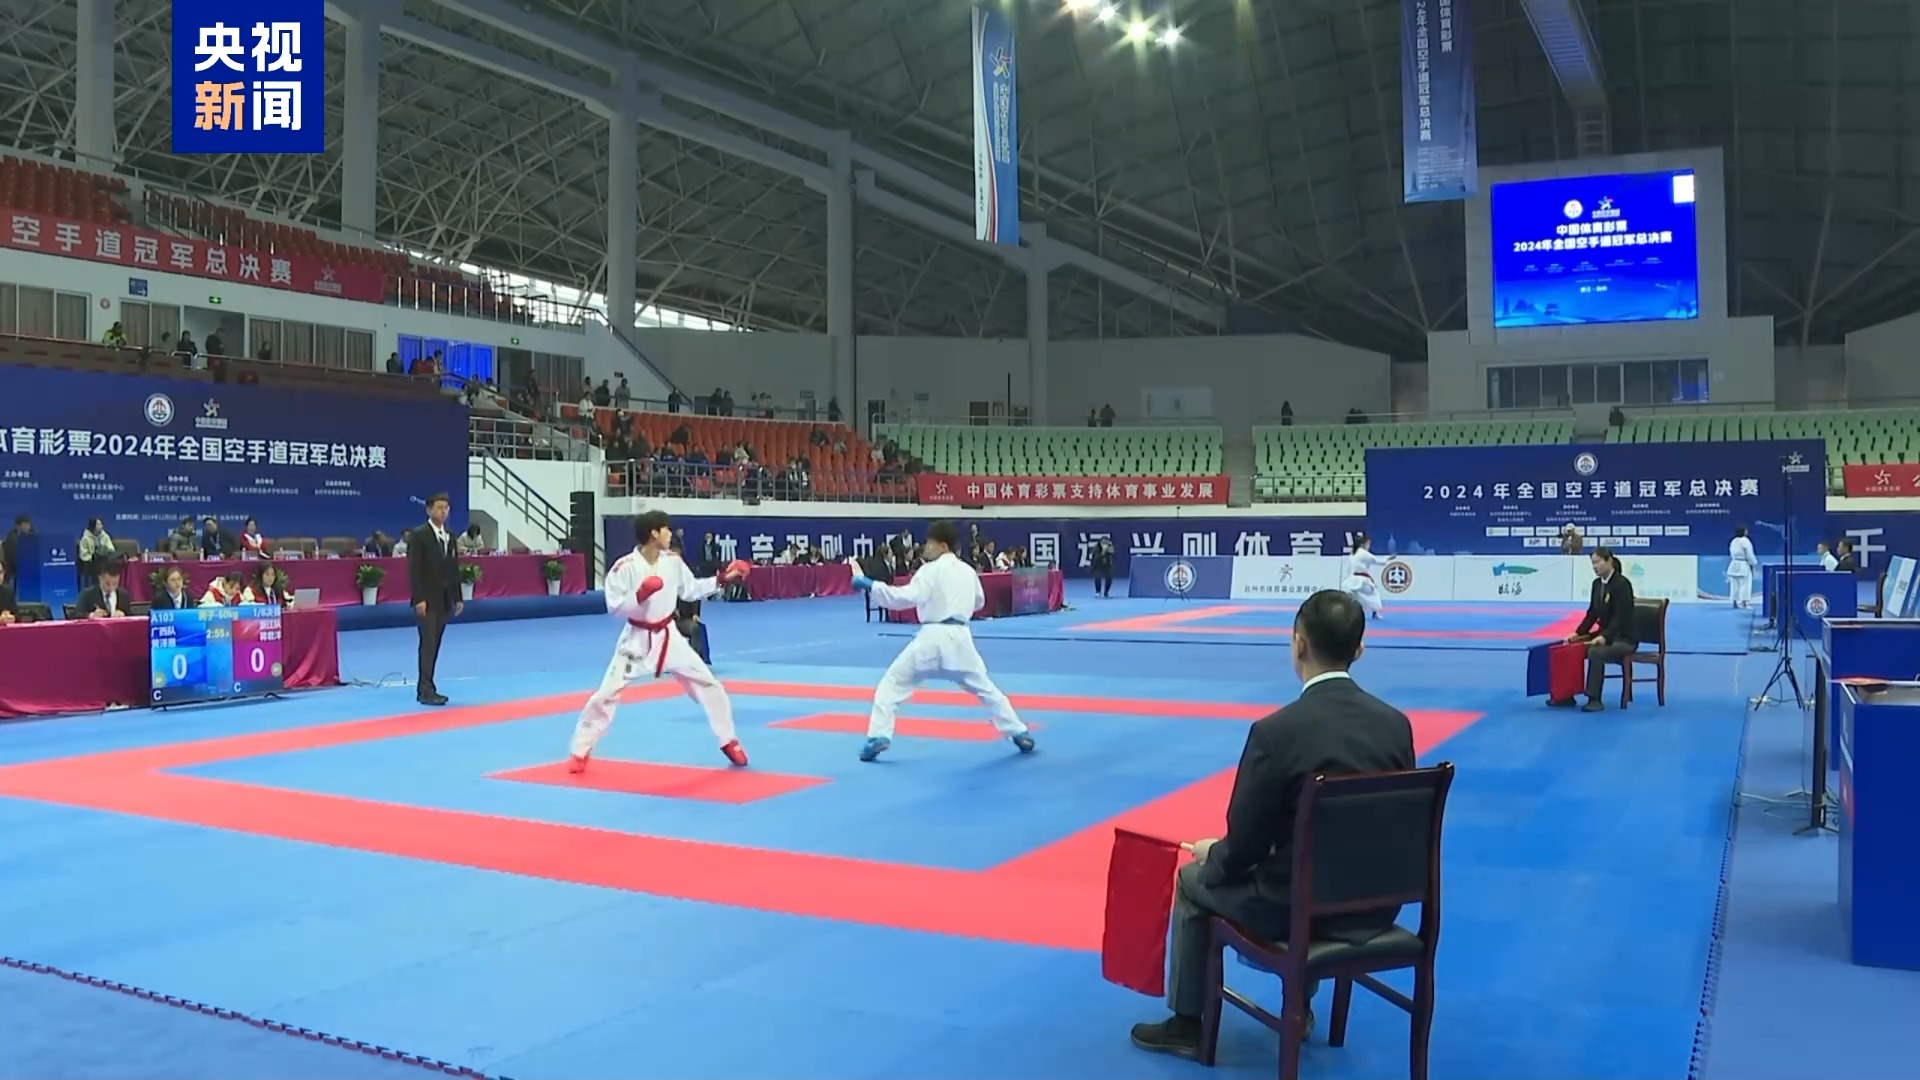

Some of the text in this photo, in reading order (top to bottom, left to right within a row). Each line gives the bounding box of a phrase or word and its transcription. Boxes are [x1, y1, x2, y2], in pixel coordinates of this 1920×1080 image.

[1556, 220, 1628, 236] 中国体育彩票
[11, 214, 293, 286] 空手道冠军总决赛
[1513, 231, 1673, 252] 2024年全国空手道冠军总决赛
[967, 482, 1213, 499] 中国体育彩票支持体育事业发展
[151, 612, 175, 623] A103
[172, 653, 188, 680] 0
[250, 647, 265, 673] 0
[153, 690, 162, 700] C
[233, 682, 242, 692] C
